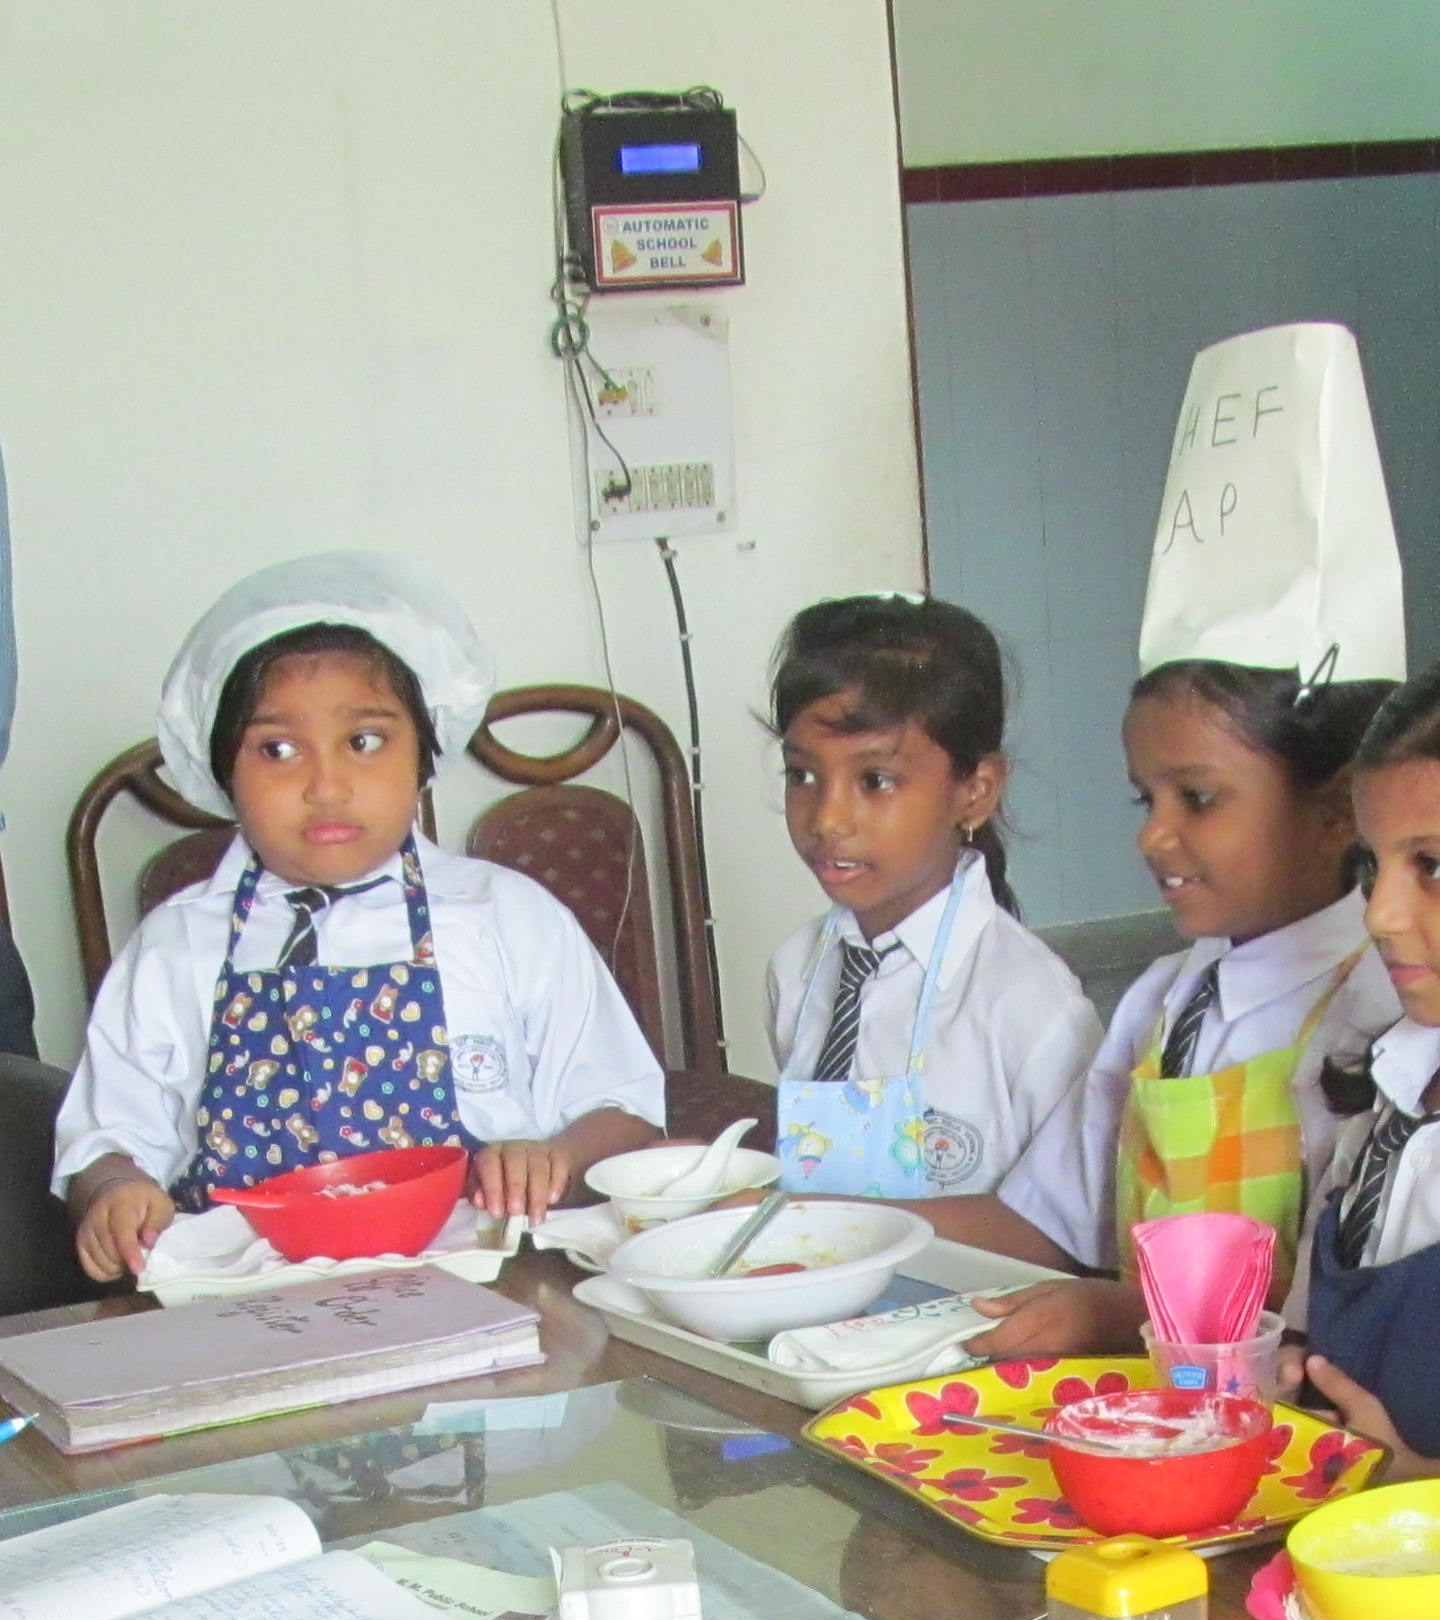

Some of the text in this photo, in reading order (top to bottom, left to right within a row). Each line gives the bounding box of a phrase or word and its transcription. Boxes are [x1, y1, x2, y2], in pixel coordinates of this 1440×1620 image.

[622, 217, 710, 234] AUTOMATIC
[636, 236, 698, 252] SCHOOL
[649, 256, 688, 269] BELL
